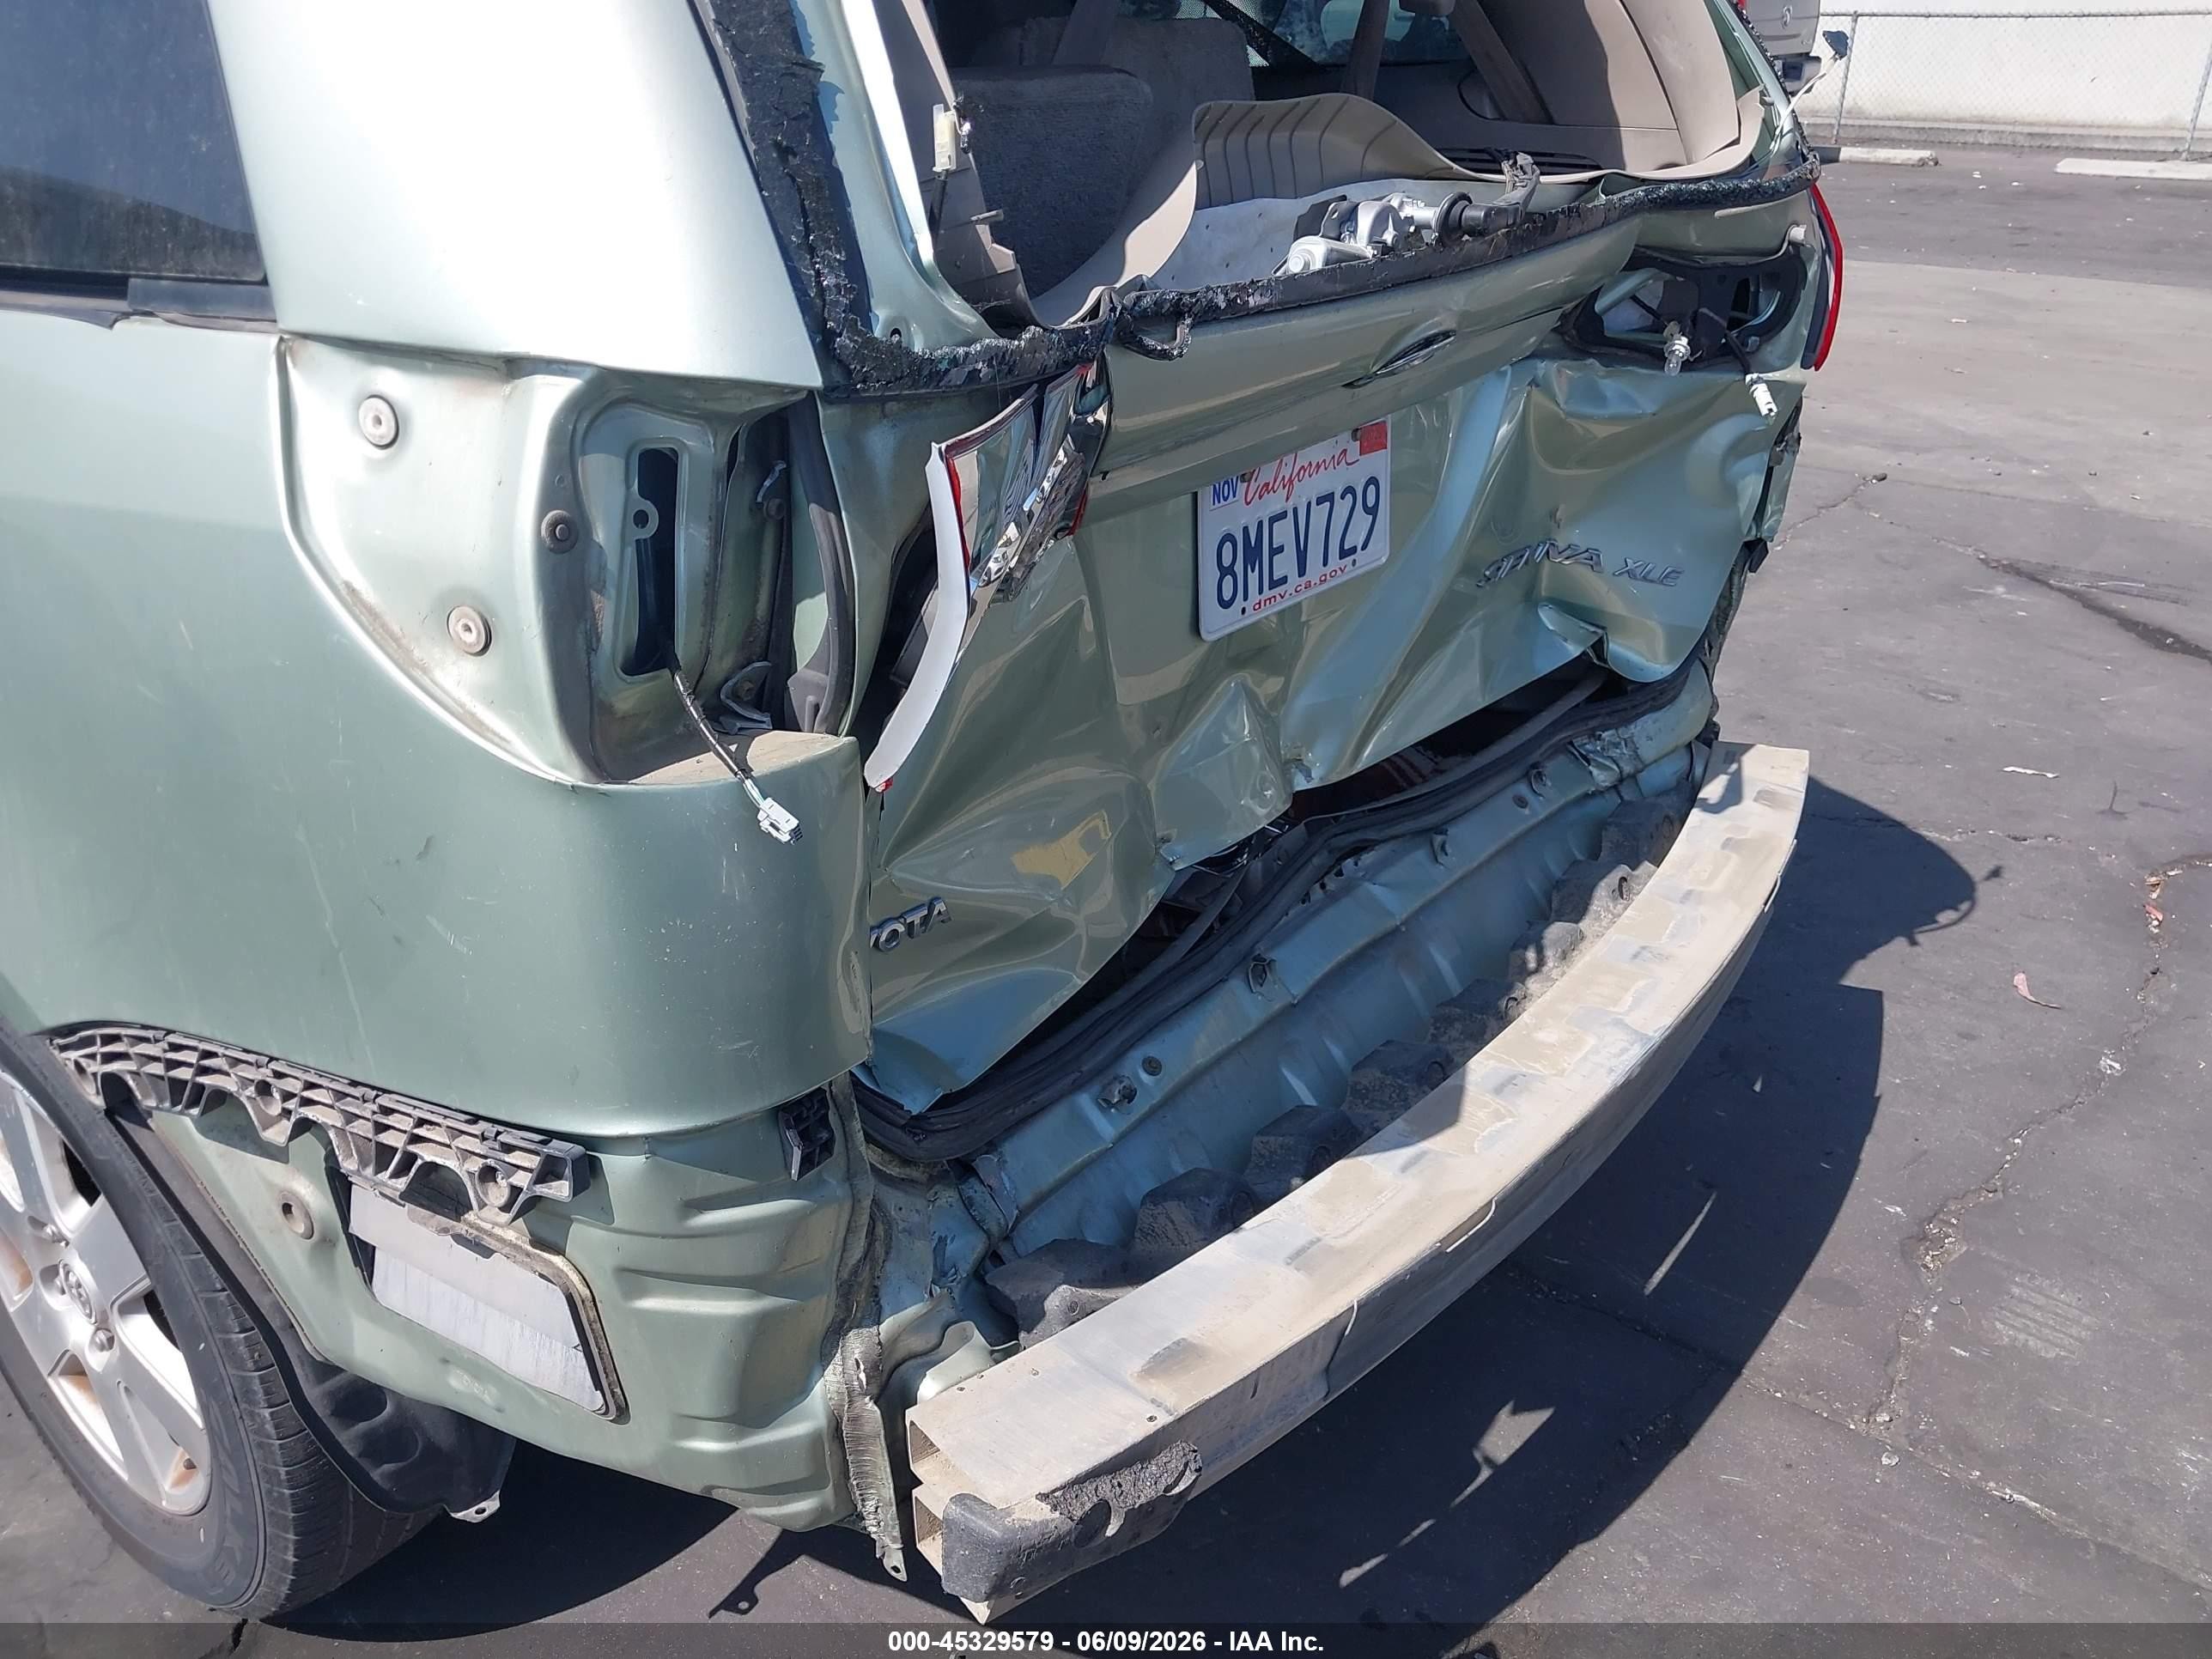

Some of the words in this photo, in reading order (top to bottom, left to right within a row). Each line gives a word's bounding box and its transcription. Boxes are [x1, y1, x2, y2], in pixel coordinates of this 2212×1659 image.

[1212, 477, 1239, 506] NOV
[1243, 446, 1359, 507] California
[1216, 476, 1380, 610] 8MEV729
[1253, 564, 1347, 612] dmv.ca.gov
[1613, 557, 1684, 586] XLE
